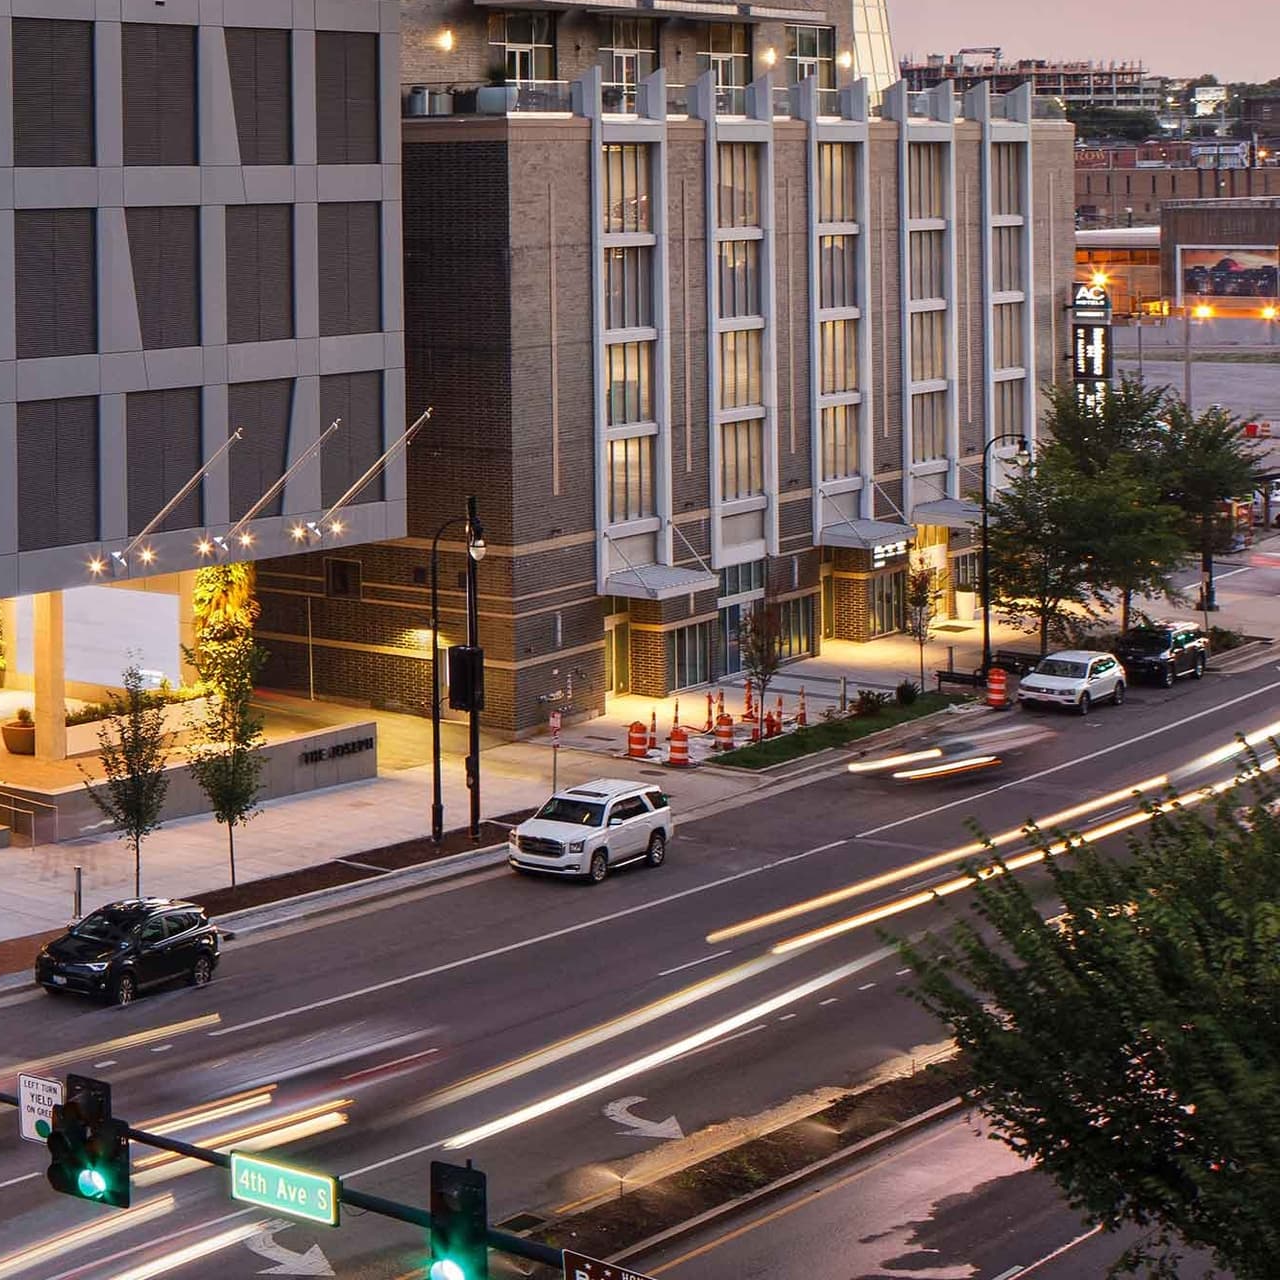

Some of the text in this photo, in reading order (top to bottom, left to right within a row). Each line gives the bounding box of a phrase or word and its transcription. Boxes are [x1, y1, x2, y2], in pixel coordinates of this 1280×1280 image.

[1076, 286, 1105, 300] AC
[23, 1079, 58, 1095] LEFT TURN
[30, 1093, 53, 1107] YIELD
[26, 1104, 53, 1118] ON GREE
[239, 1168, 329, 1212] 4th Ave S
